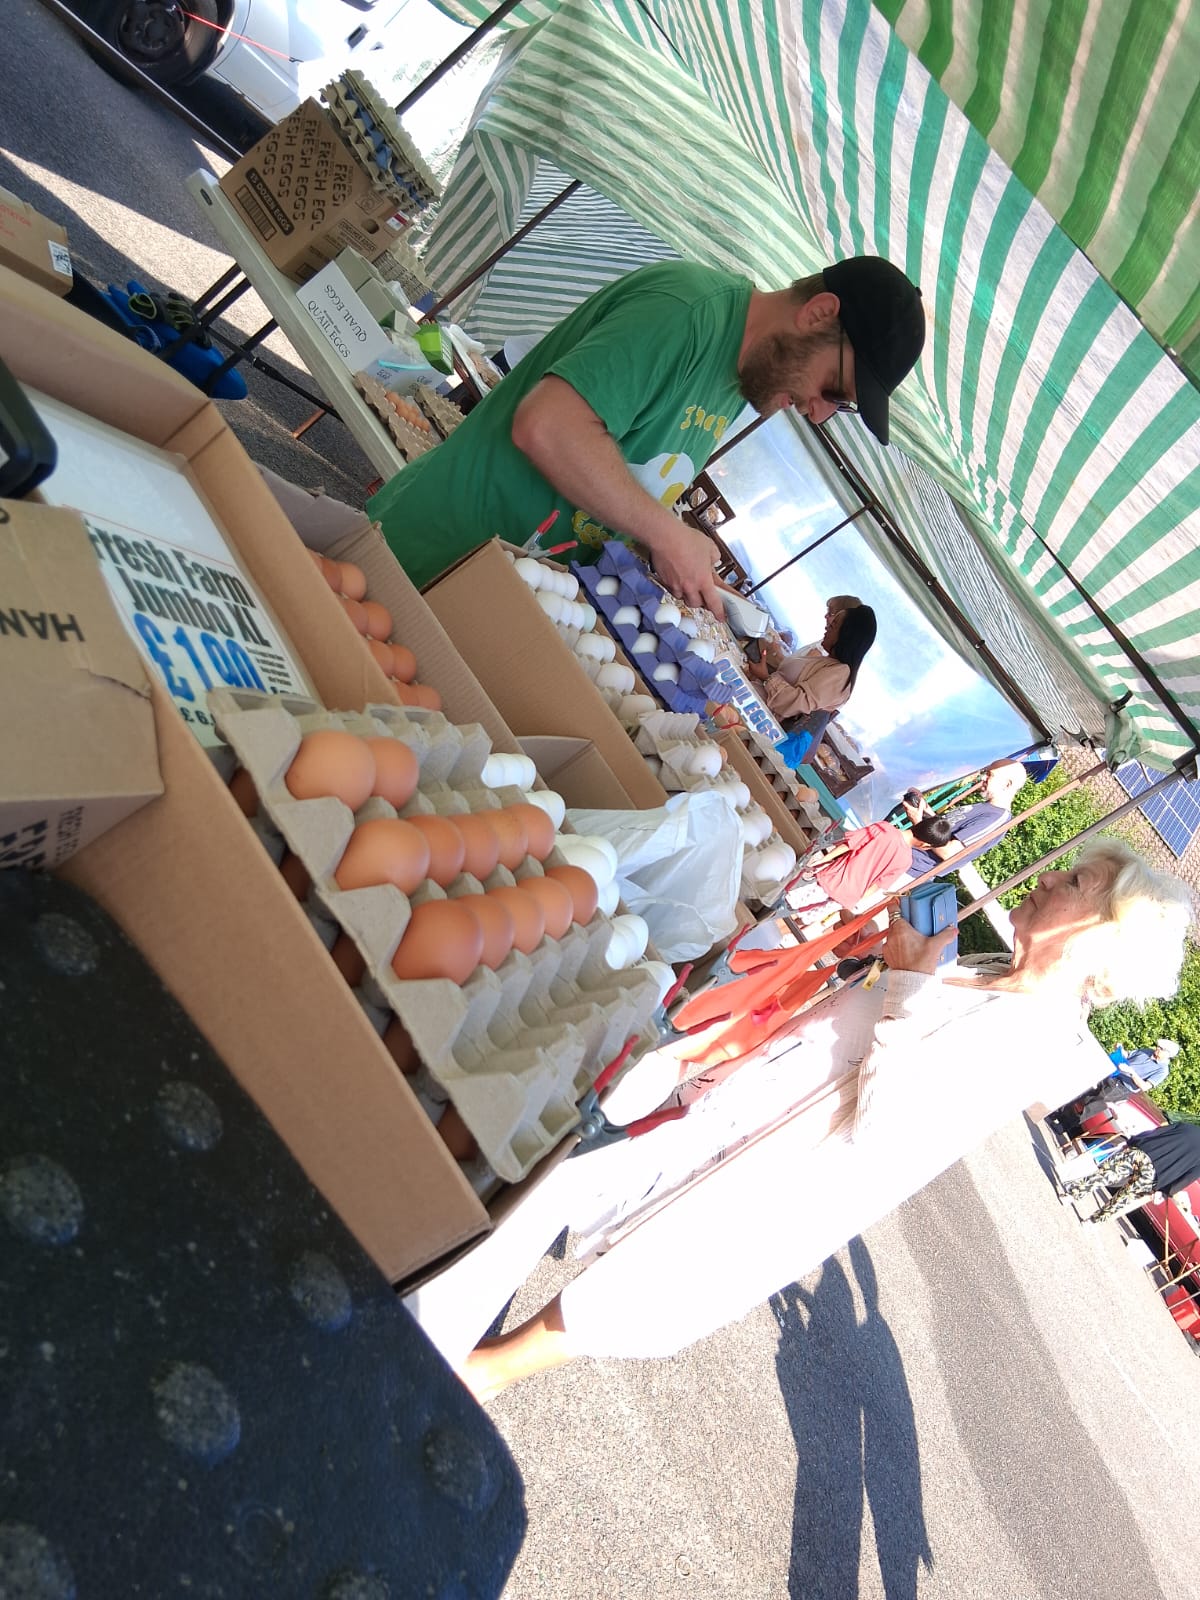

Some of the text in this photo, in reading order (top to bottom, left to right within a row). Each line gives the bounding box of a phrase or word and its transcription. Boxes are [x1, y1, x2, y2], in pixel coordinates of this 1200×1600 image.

[262, 133, 280, 176] EGGS
[278, 153, 295, 198] EGGS
[292, 119, 318, 220] FRESH EGGS
[314, 140, 332, 191] FRESH
[257, 182, 276, 210] DOZEN
[274, 207, 291, 231] EGGS
[324, 284, 345, 312] EGGS
[307, 300, 330, 334] QUAIL
[329, 331, 351, 358] EGGS
[343, 310, 368, 342] QUAIL
[170, 548, 256, 609] Farm
[115, 566, 272, 648] Jumbo XL
